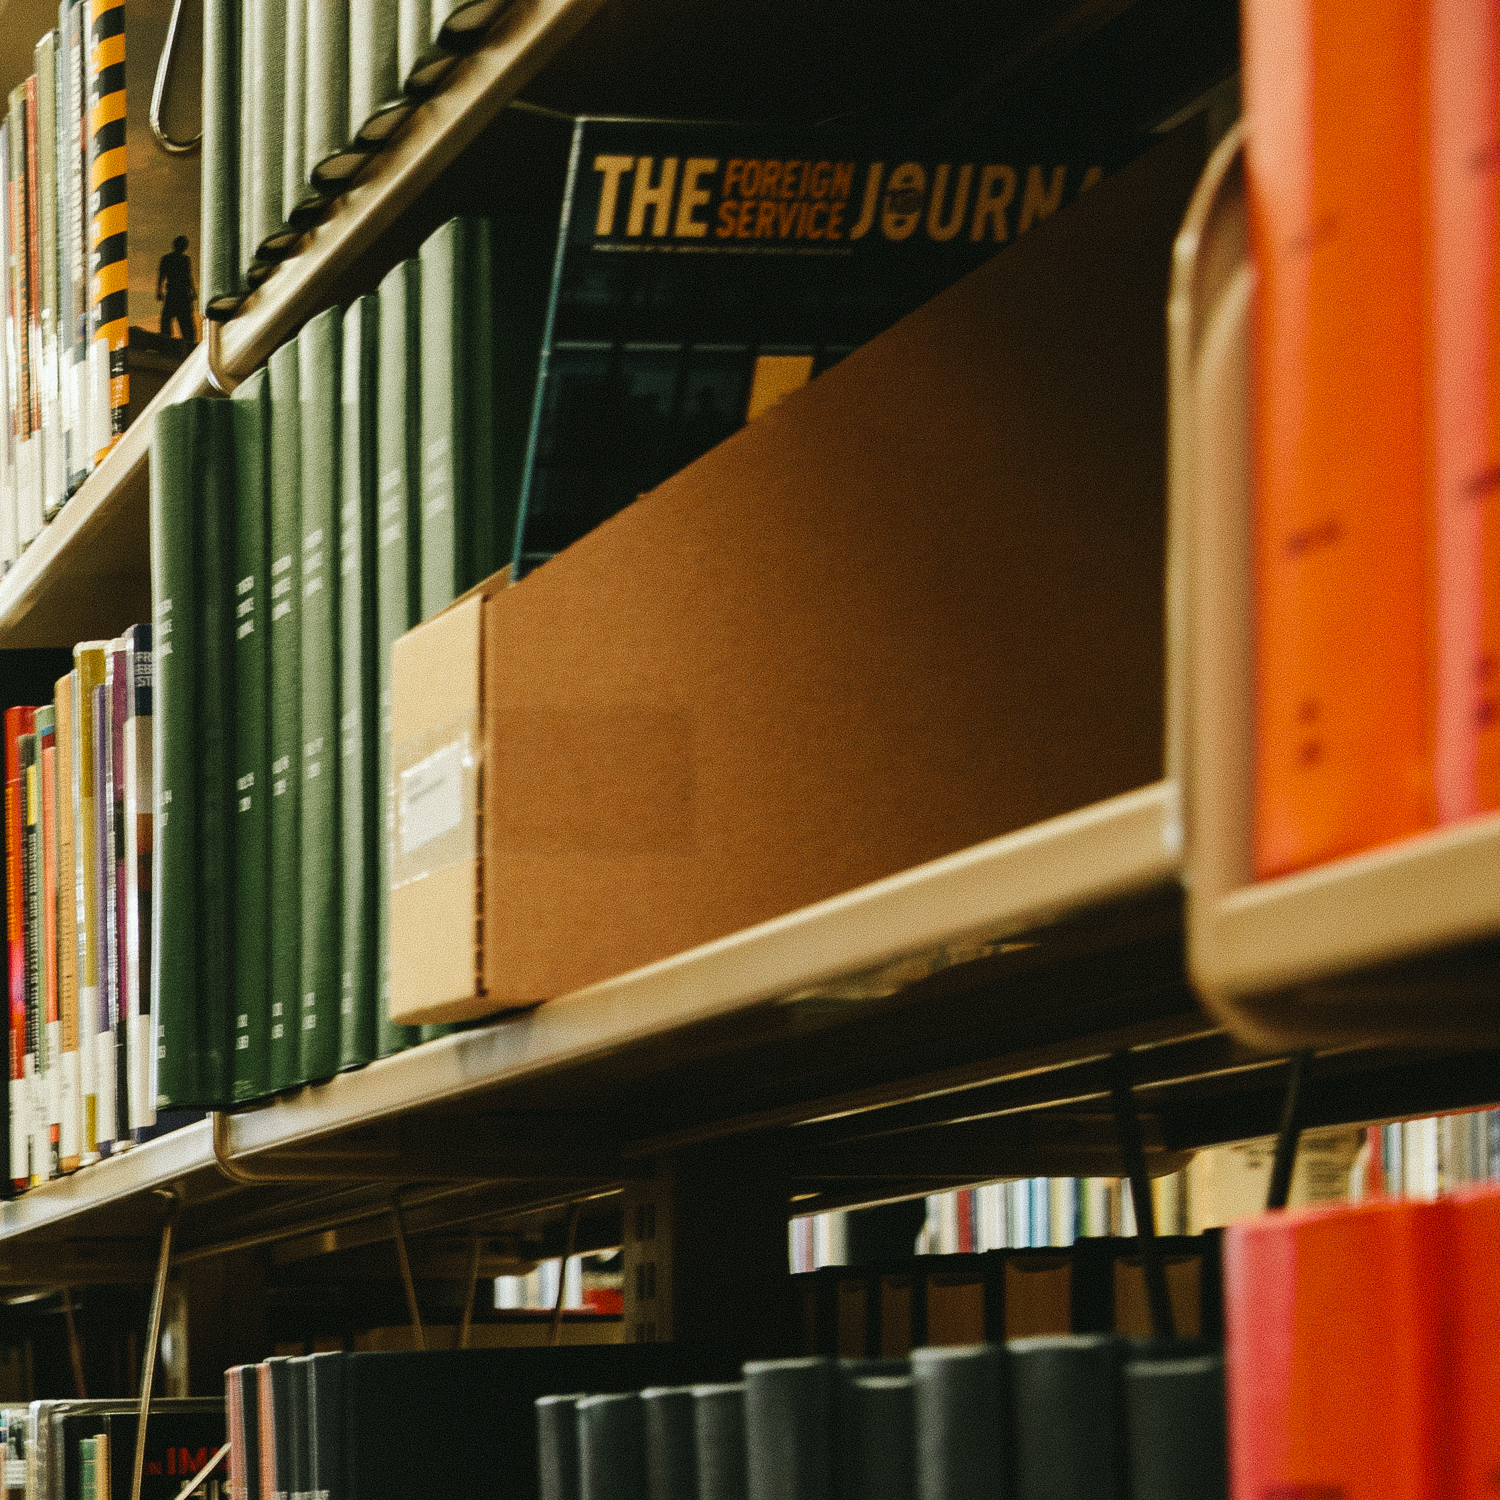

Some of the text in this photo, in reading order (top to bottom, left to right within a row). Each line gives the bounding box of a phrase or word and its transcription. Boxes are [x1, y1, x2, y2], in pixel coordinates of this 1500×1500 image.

[592, 154, 717, 238] THE
[723, 157, 854, 200] FOREIGN
[715, 199, 848, 242] SERVICE
